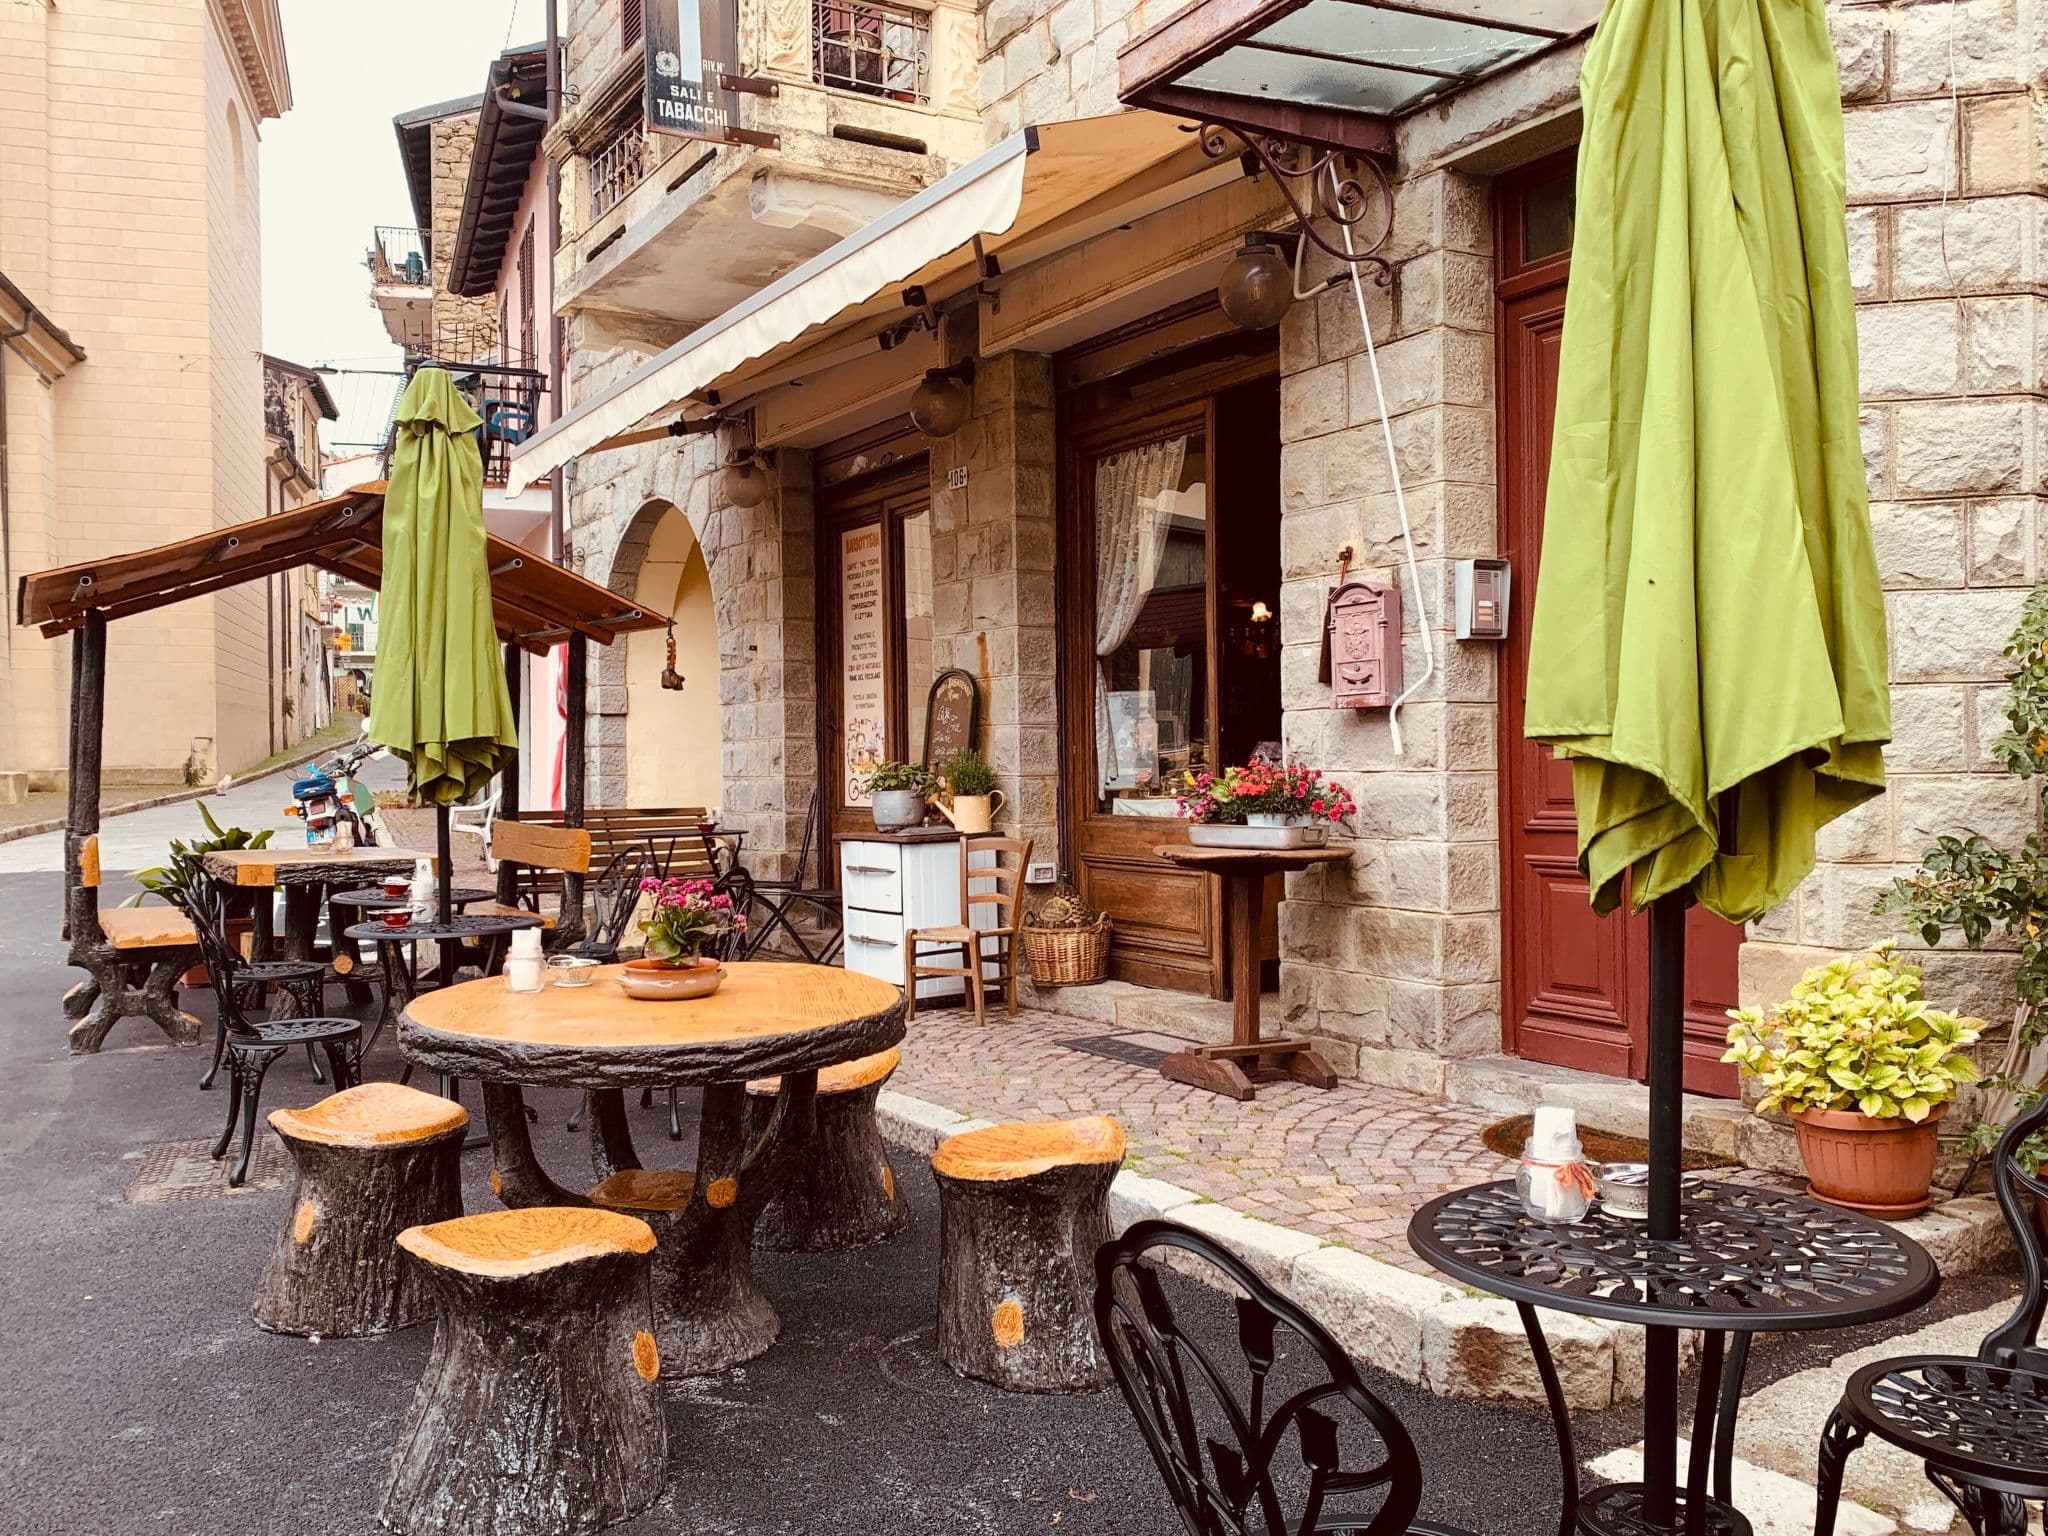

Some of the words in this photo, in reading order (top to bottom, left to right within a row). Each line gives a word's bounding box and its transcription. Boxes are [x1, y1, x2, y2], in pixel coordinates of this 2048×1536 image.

[670, 85, 701, 100] SALI
[706, 91, 714, 103] E
[657, 98, 728, 127] TABACCHI
[951, 469, 964, 488] 106
